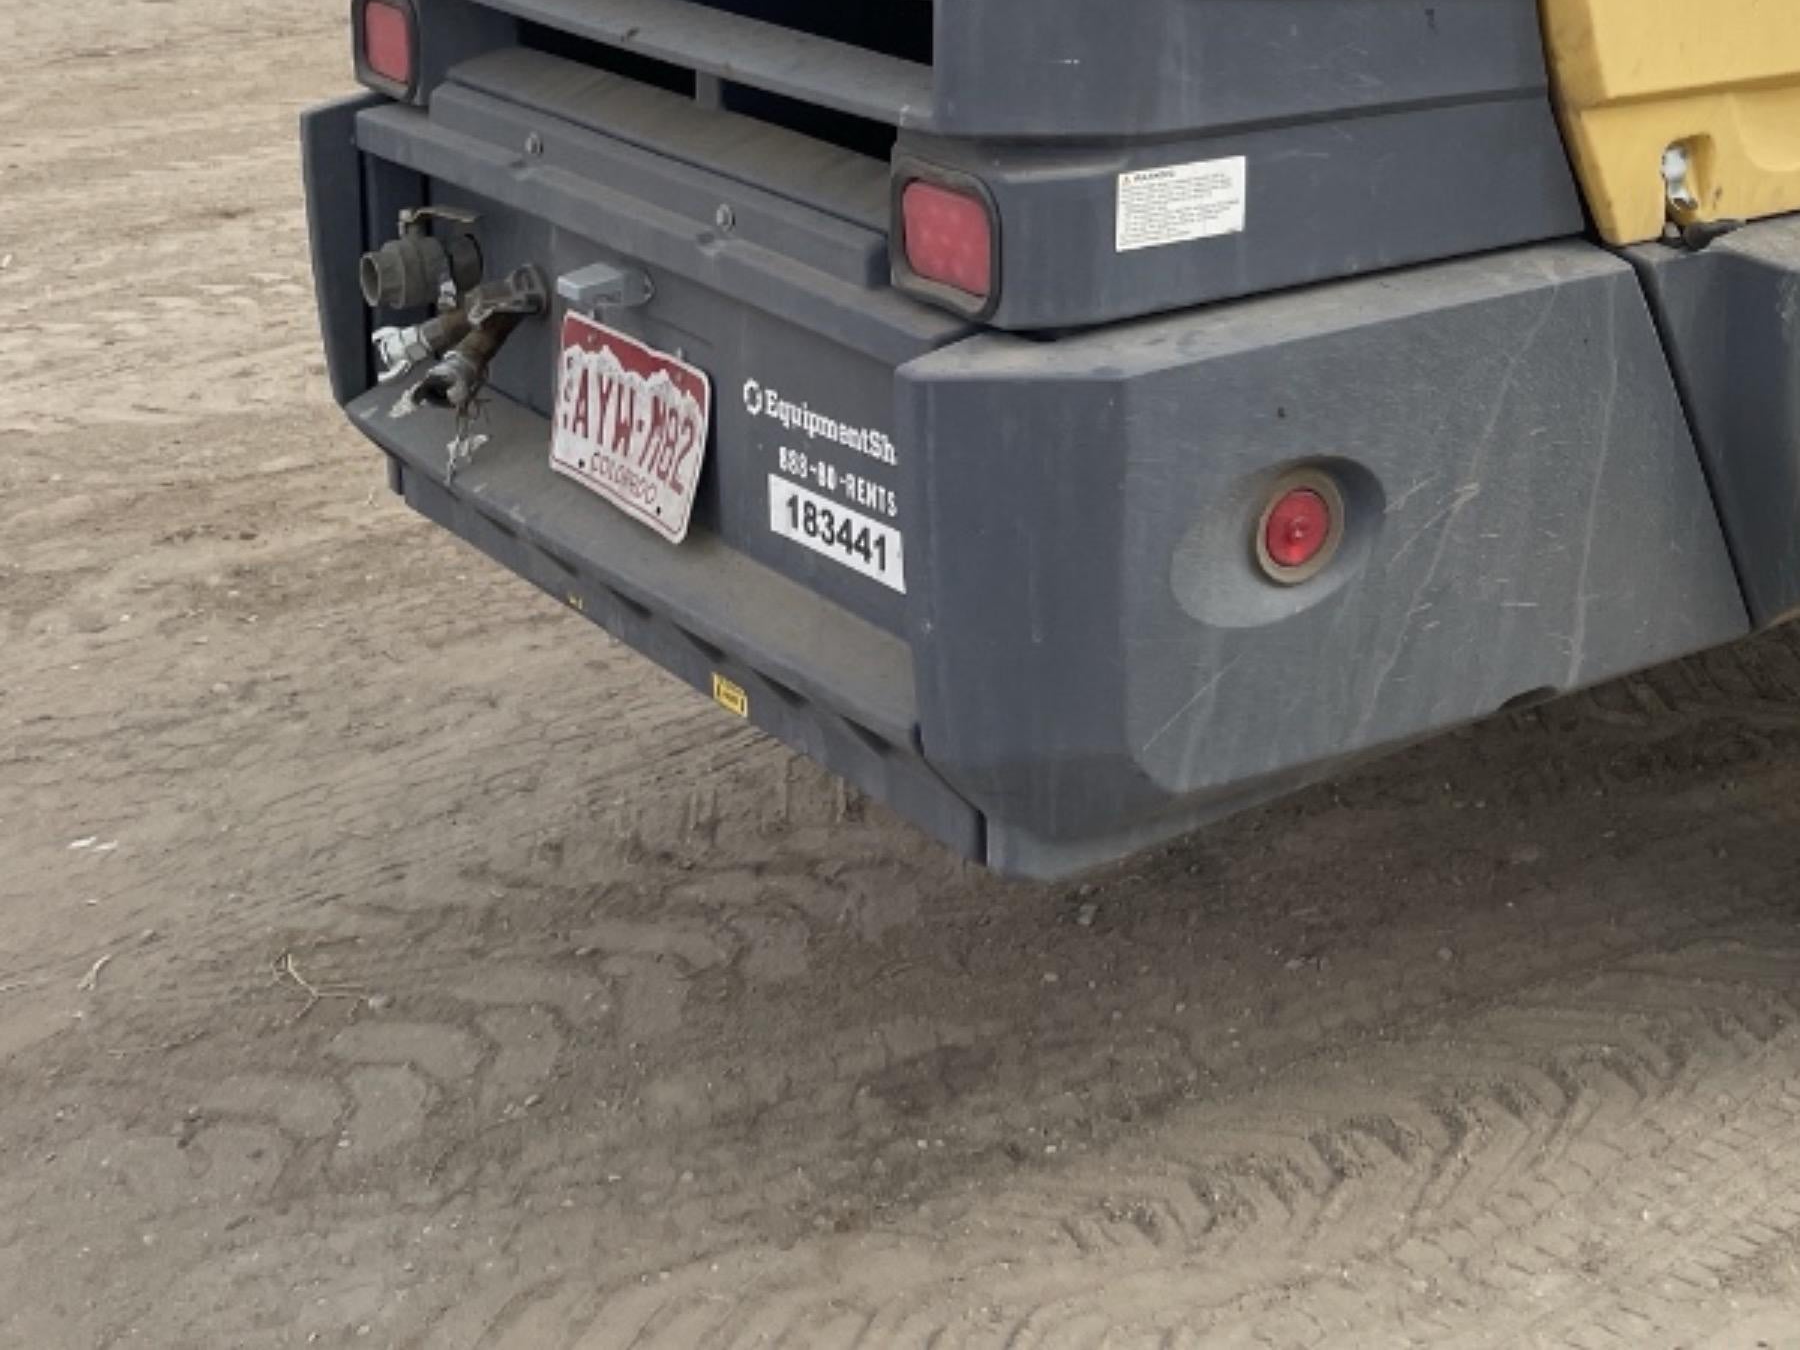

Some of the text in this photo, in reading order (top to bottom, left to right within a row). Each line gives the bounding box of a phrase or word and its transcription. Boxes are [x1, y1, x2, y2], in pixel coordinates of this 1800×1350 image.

[571, 367, 696, 496] AYW-M82
[590, 451, 657, 505] COLORADO
[779, 446, 898, 517] 888-80-RENTS
[785, 494, 887, 572] 183441
